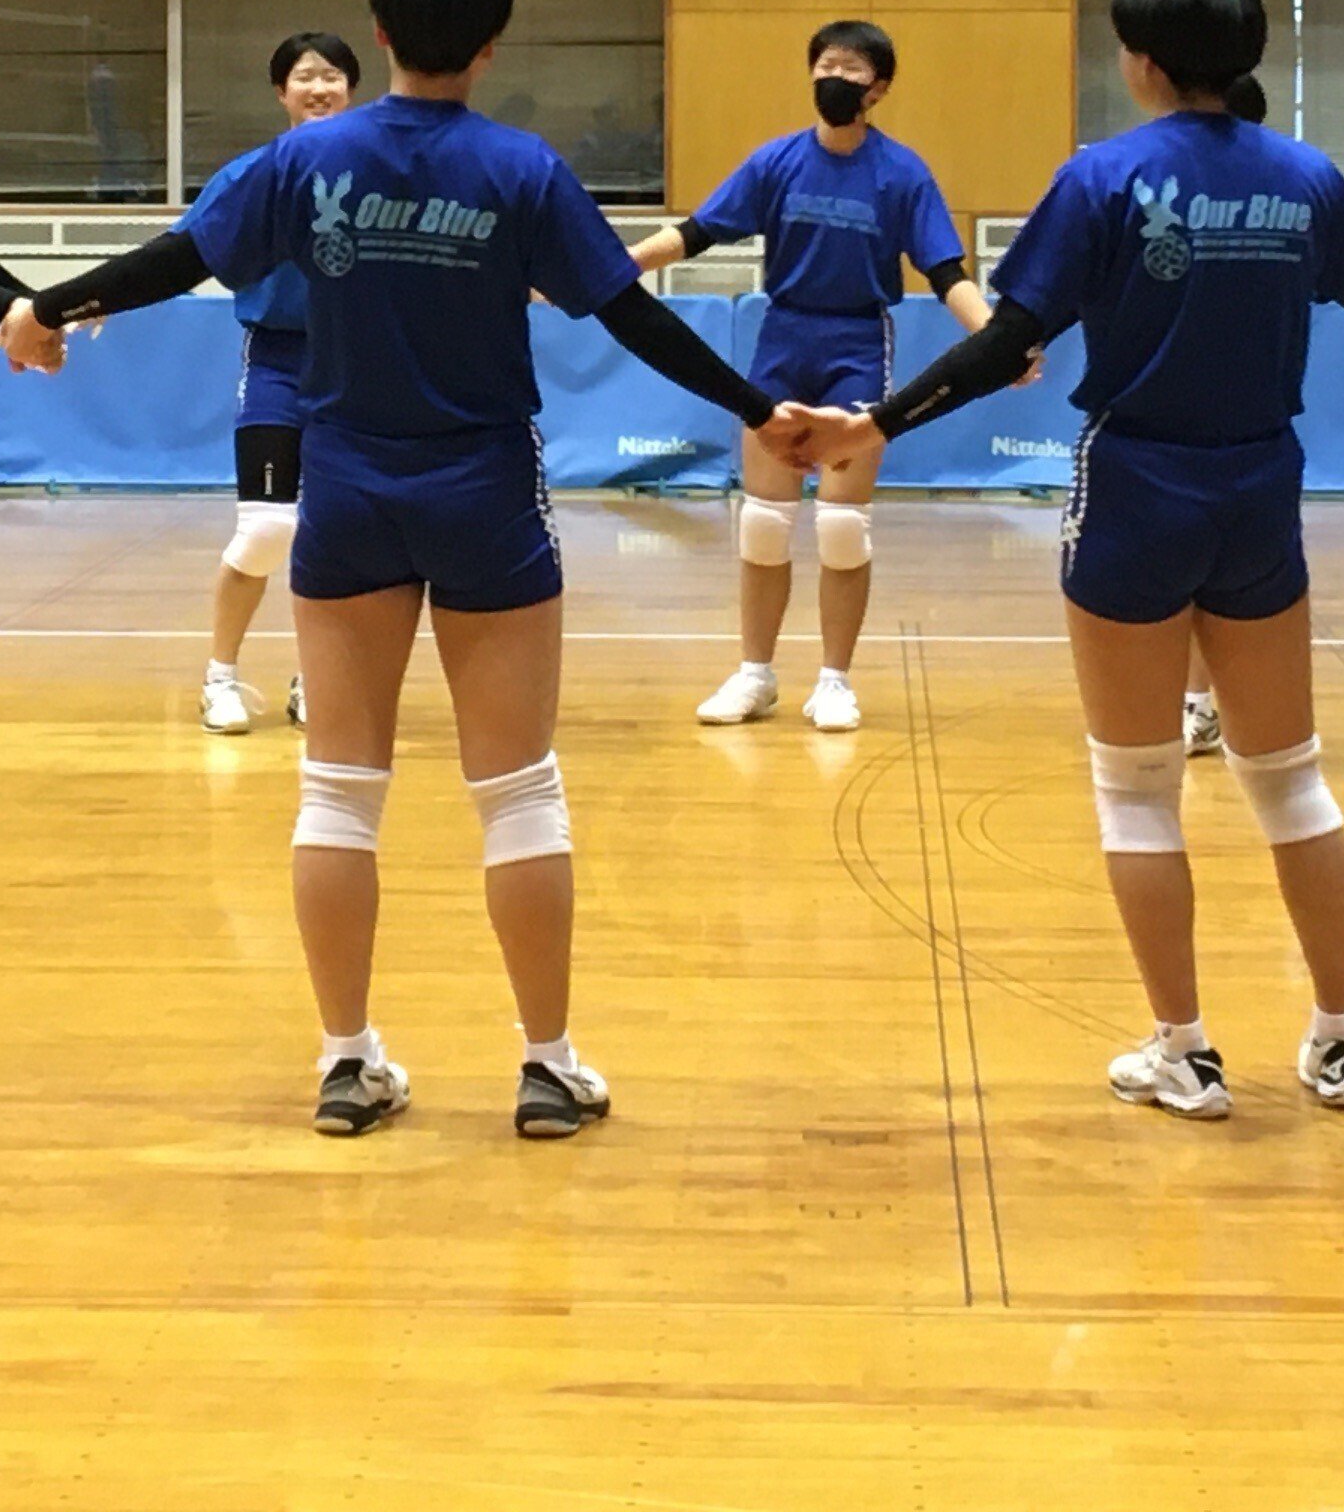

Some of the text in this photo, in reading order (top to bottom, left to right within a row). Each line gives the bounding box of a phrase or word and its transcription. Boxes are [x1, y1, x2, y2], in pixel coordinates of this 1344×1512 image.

[355, 193, 498, 240] Our Blue
[1187, 194, 1313, 232] Our Blue
[617, 435, 696, 455] Nittaku
[991, 435, 1072, 457] Nittaku
